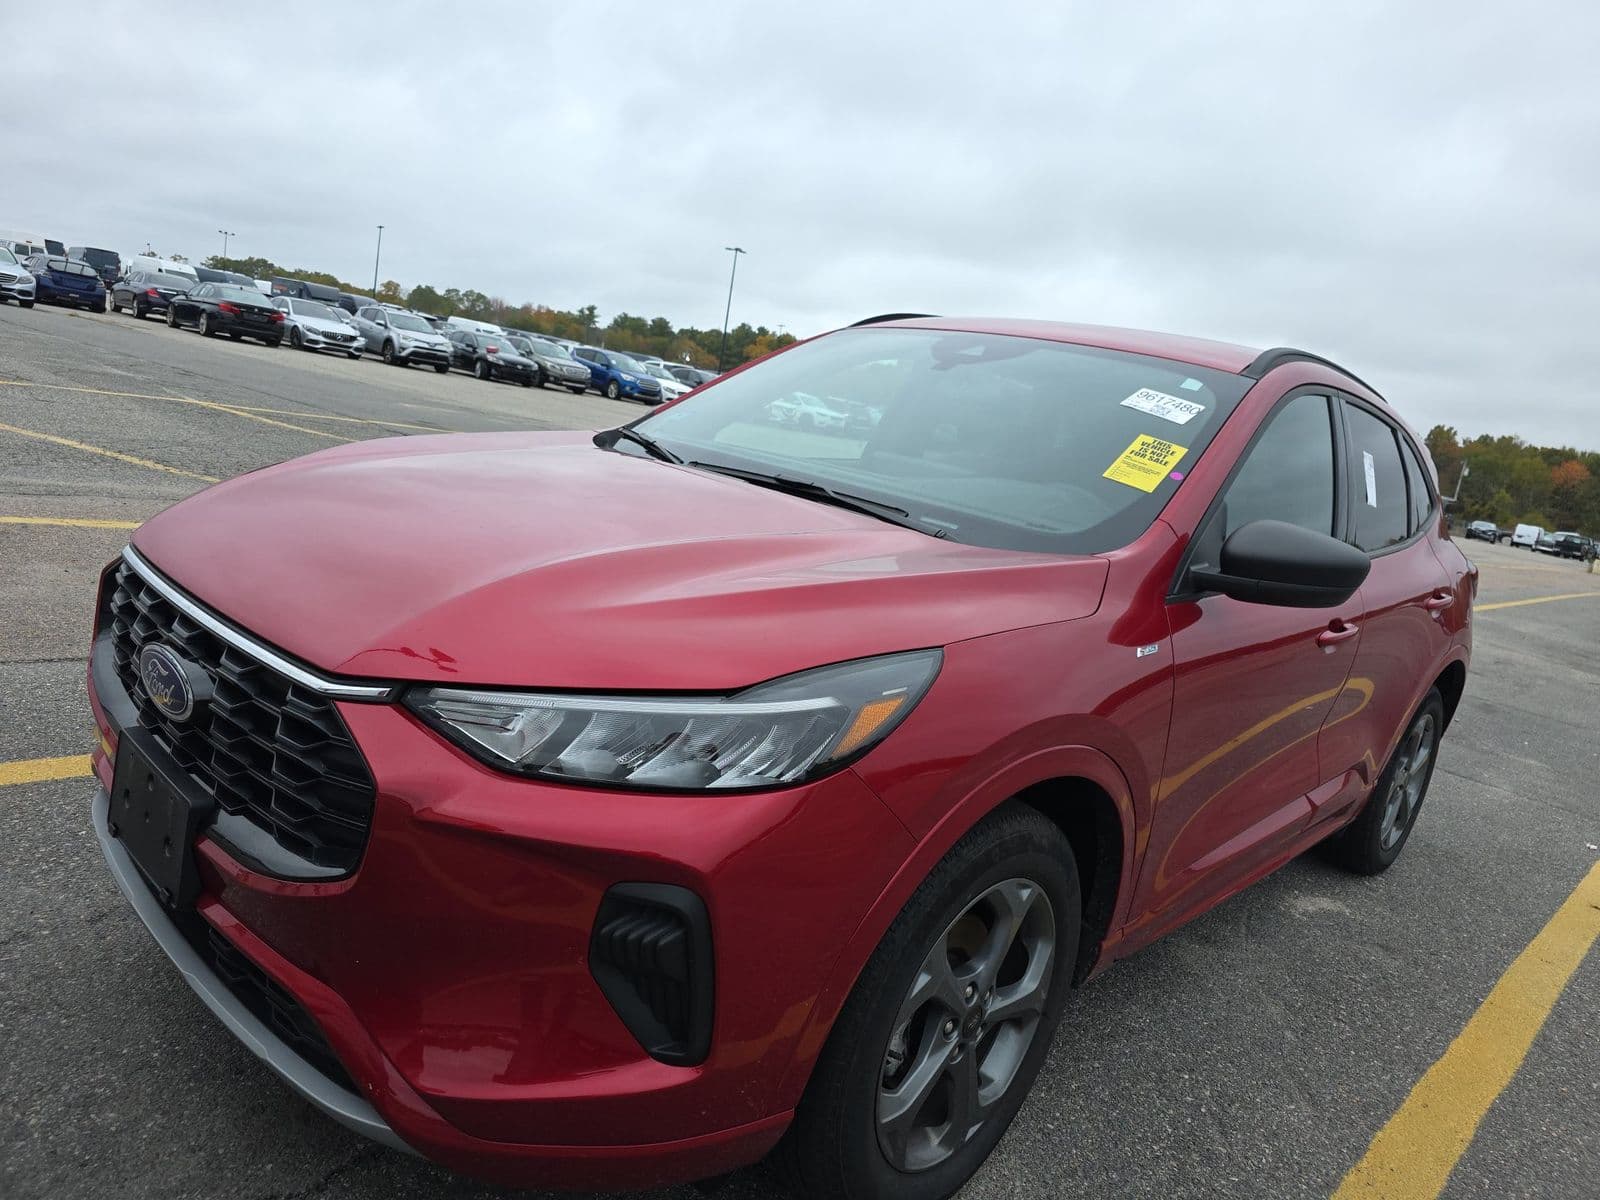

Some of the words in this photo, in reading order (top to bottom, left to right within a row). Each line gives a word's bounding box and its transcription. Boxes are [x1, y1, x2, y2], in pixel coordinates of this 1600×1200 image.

[1137, 391, 1201, 415] 9617480
[1141, 441, 1177, 456] VEHICLE
[1152, 439, 1173, 449] THIS
[1129, 450, 1147, 459] FOR
[1147, 456, 1169, 467] SALE
[1149, 449, 1168, 460] NOT
[146, 658, 175, 706] Ford
